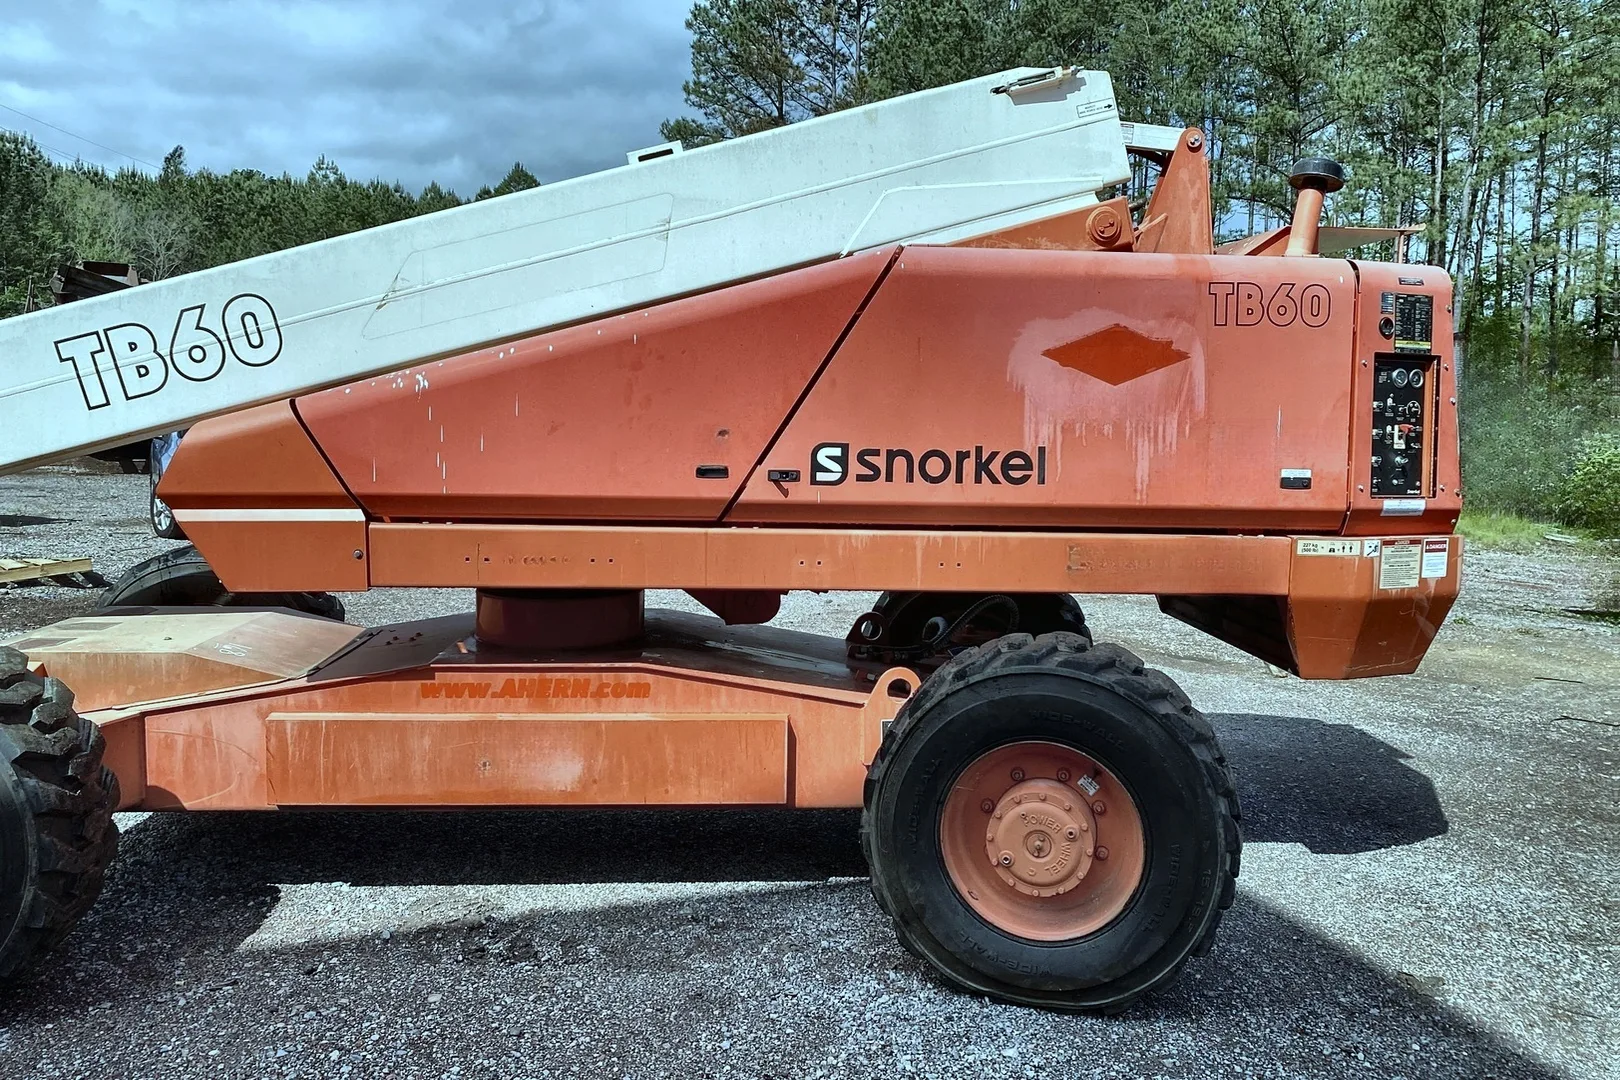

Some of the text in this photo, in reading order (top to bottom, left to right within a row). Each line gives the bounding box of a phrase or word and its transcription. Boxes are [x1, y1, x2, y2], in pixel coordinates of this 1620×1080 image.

[1208, 281, 1331, 328] TB60
[53, 292, 283, 411] TB60
[855, 445, 1046, 486] snorkel
[420, 678, 651, 699] www.AHERN.com
[1044, 842, 1072, 877] WHEEL
